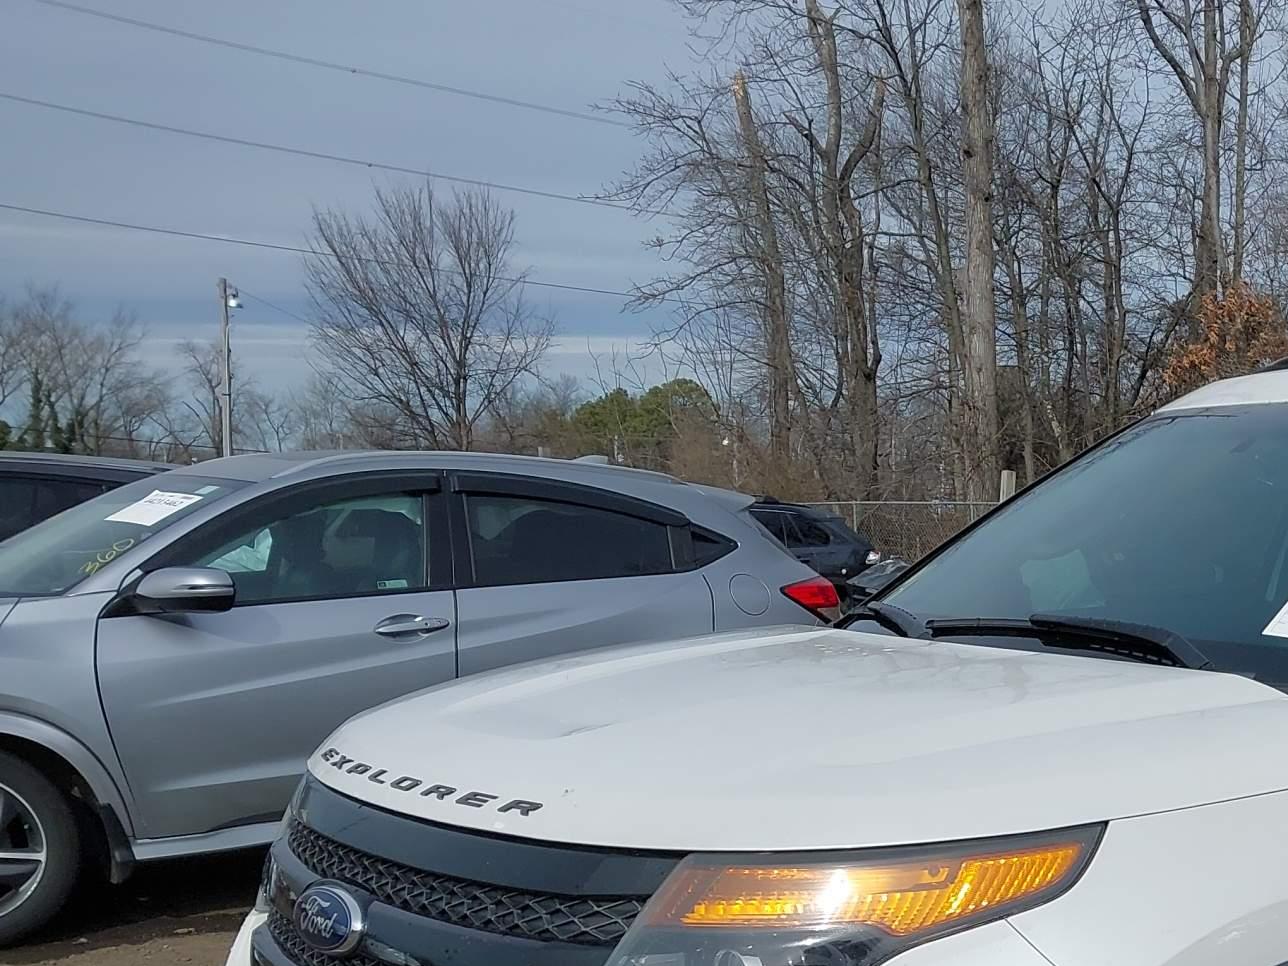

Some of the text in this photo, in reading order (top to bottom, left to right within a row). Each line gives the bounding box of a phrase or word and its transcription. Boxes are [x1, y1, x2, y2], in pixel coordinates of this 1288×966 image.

[79, 538, 135, 576] 360
[320, 747, 544, 817] EXPLORER
[300, 895, 338, 939] Ford
